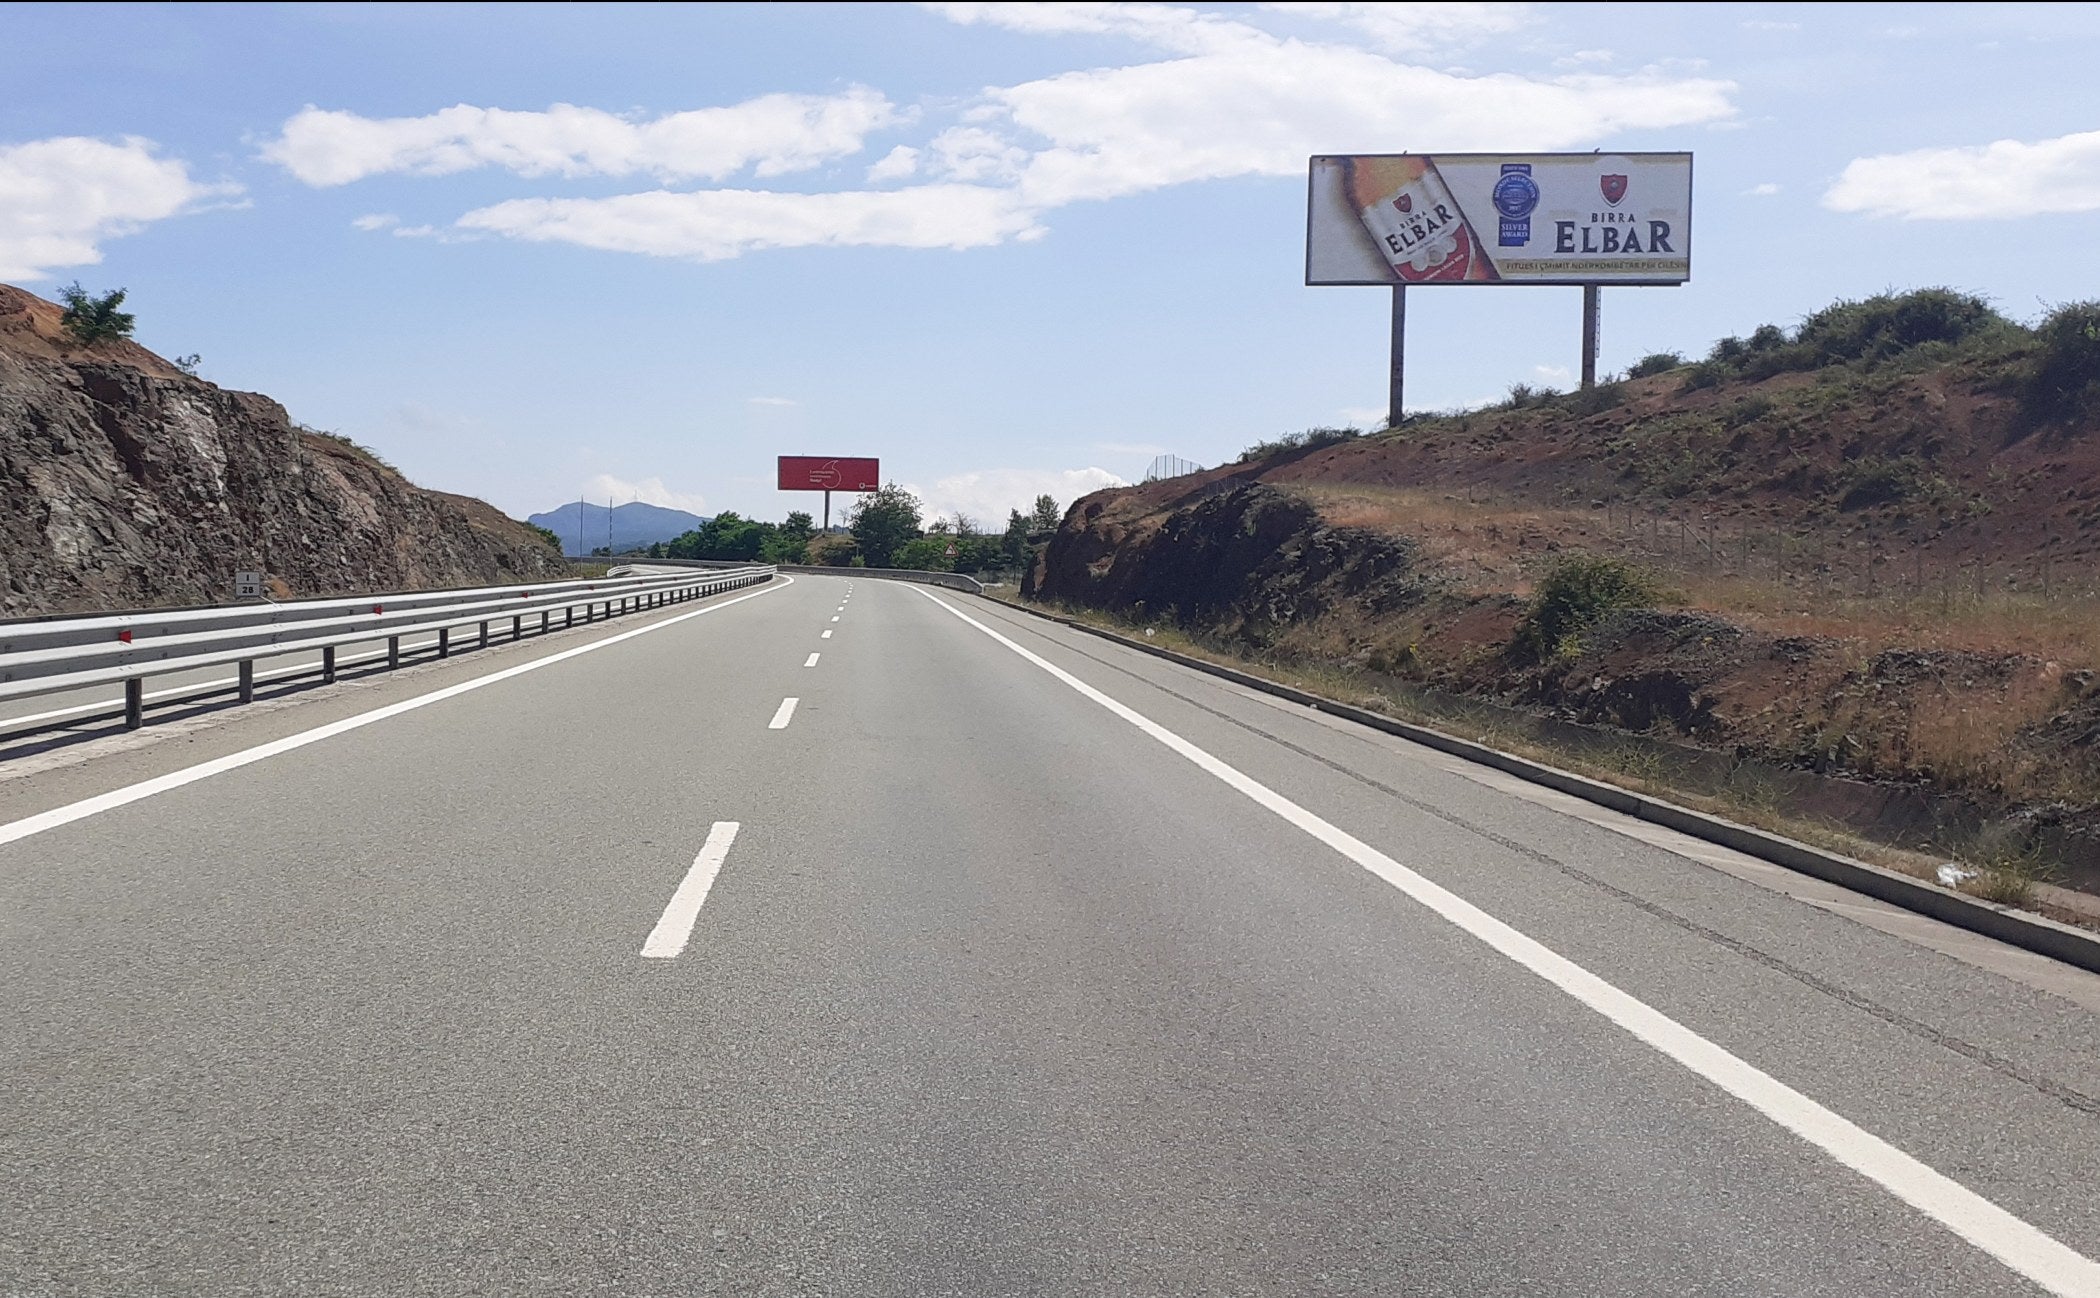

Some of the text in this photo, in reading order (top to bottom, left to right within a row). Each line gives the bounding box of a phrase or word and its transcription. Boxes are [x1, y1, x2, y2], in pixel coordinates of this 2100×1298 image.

[1399, 210, 1427, 229] BIRRA
[1591, 213, 1636, 223] BIRRA
[1385, 204, 1454, 255] ELBAR
[1501, 223, 1528, 231] SILVER
[1554, 221, 1675, 254] ELBAR
[242, 586, 254, 594] 28
